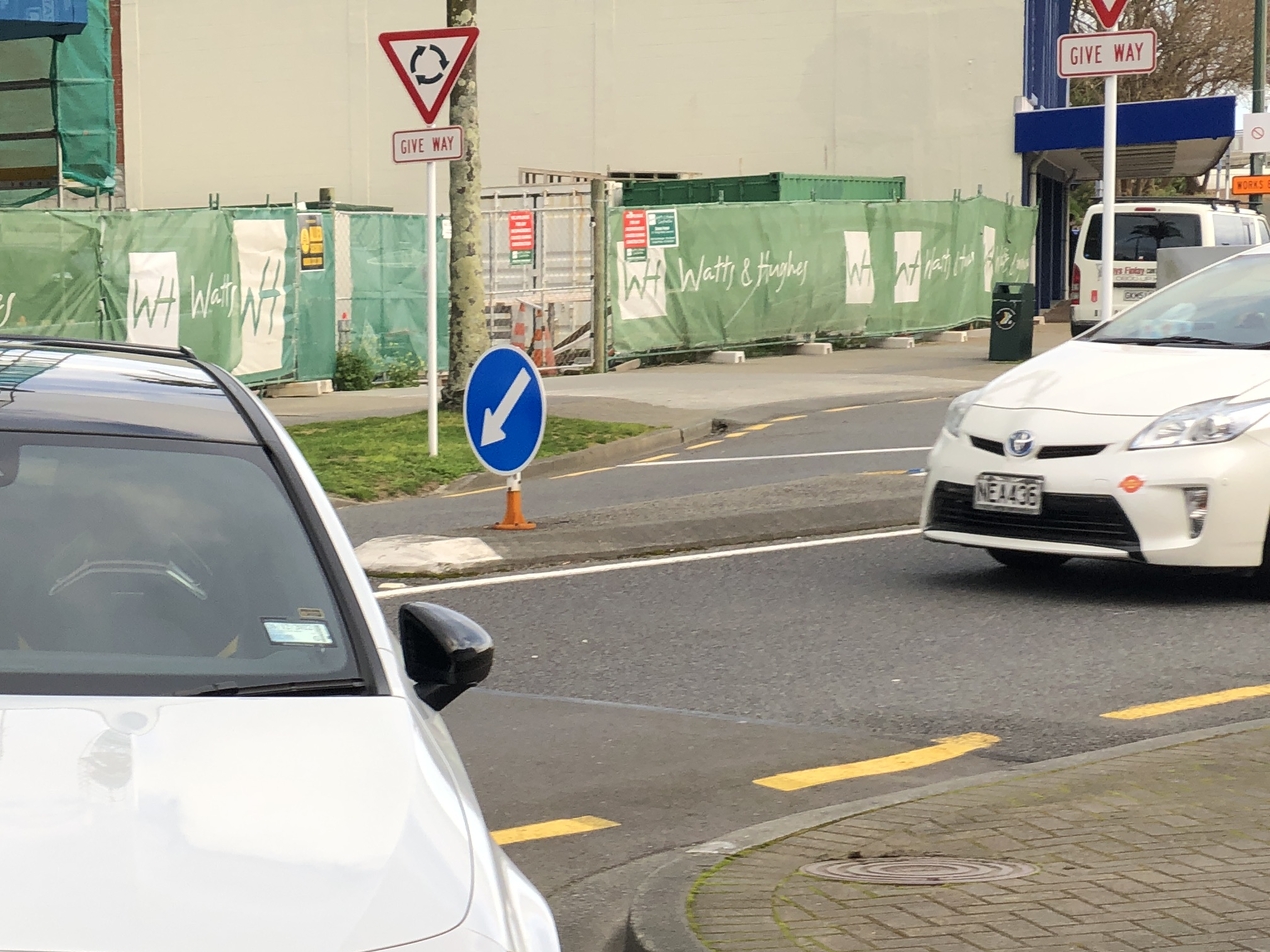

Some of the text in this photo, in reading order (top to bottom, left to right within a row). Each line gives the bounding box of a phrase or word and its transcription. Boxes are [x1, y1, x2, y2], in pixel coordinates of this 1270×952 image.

[1070, 42, 1145, 66] GIVE WAY
[400, 136, 454, 154] GIVE WAY
[1236, 180, 1264, 190] WORKS
[678, 255, 736, 292] Watts
[741, 257, 753, 287] &
[756, 250, 809, 293] Hughes
[191, 272, 238, 319] Watts
